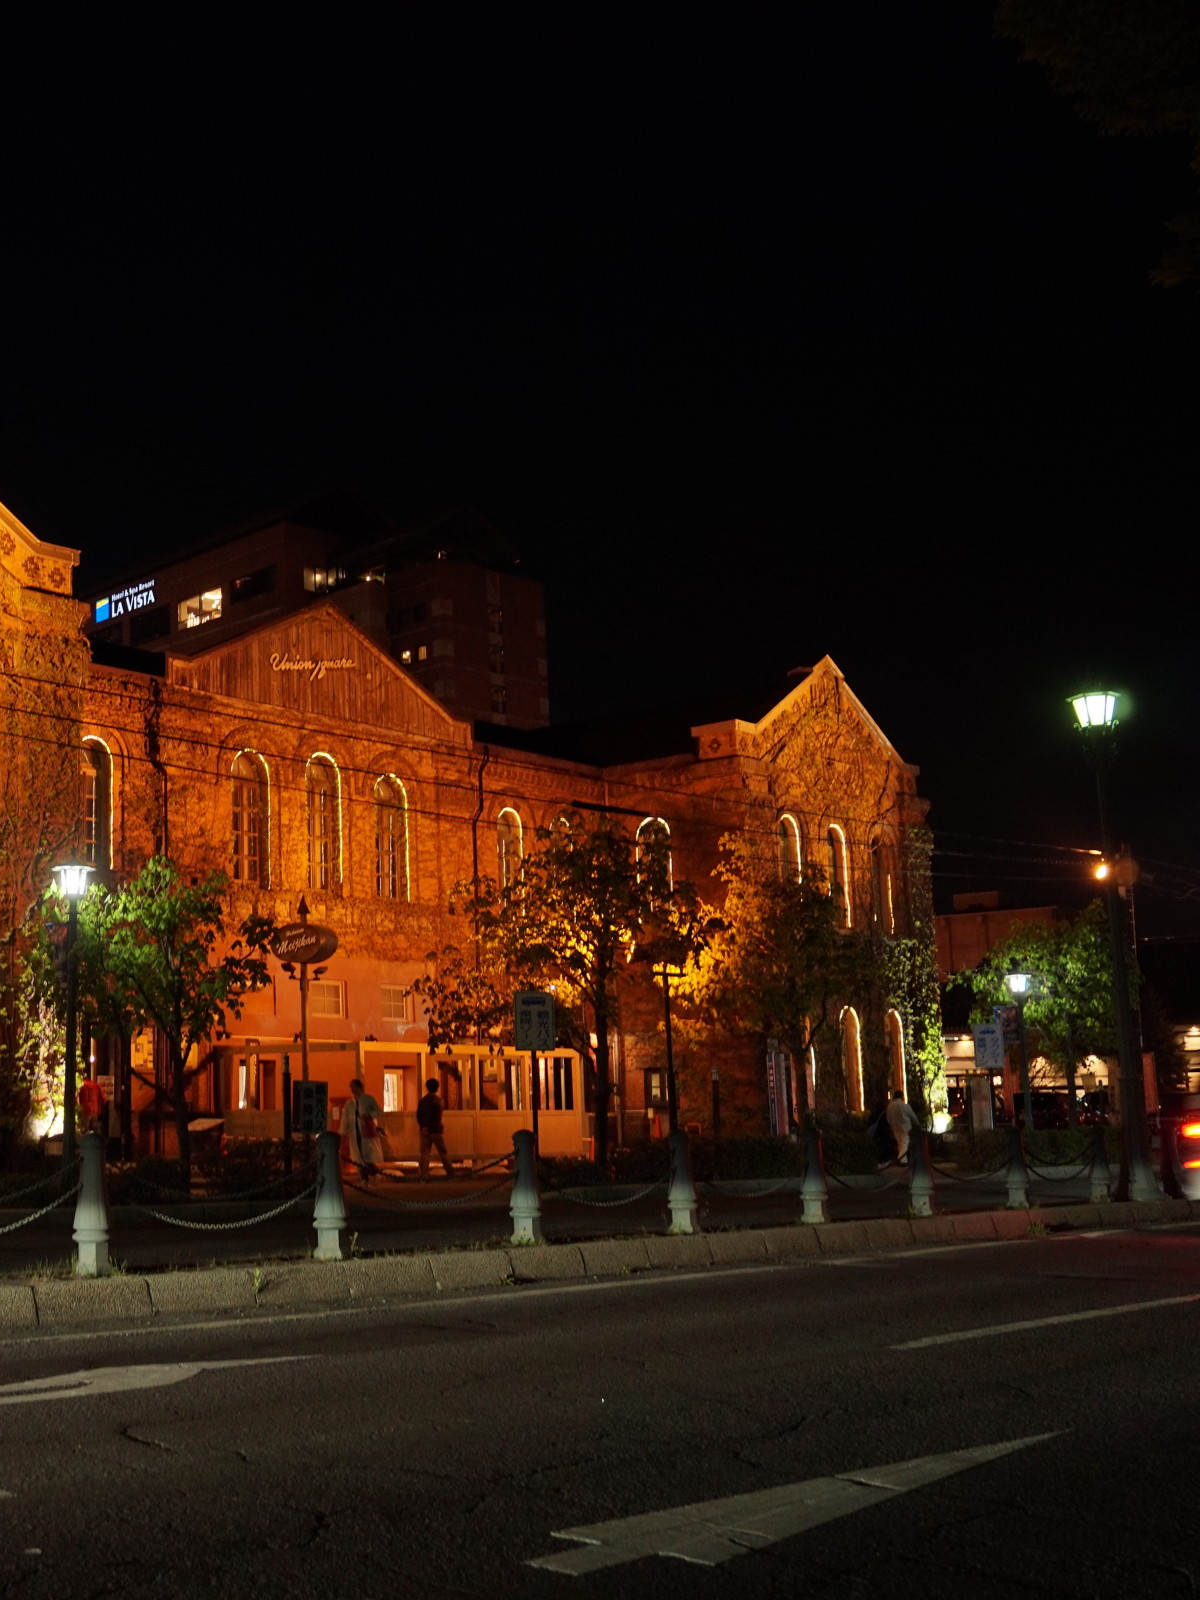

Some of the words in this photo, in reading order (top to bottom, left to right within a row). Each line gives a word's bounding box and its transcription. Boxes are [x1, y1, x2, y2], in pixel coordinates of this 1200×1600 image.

[111, 601, 124, 618] LA
[126, 589, 155, 612] VISTA
[270, 652, 315, 672] Union
